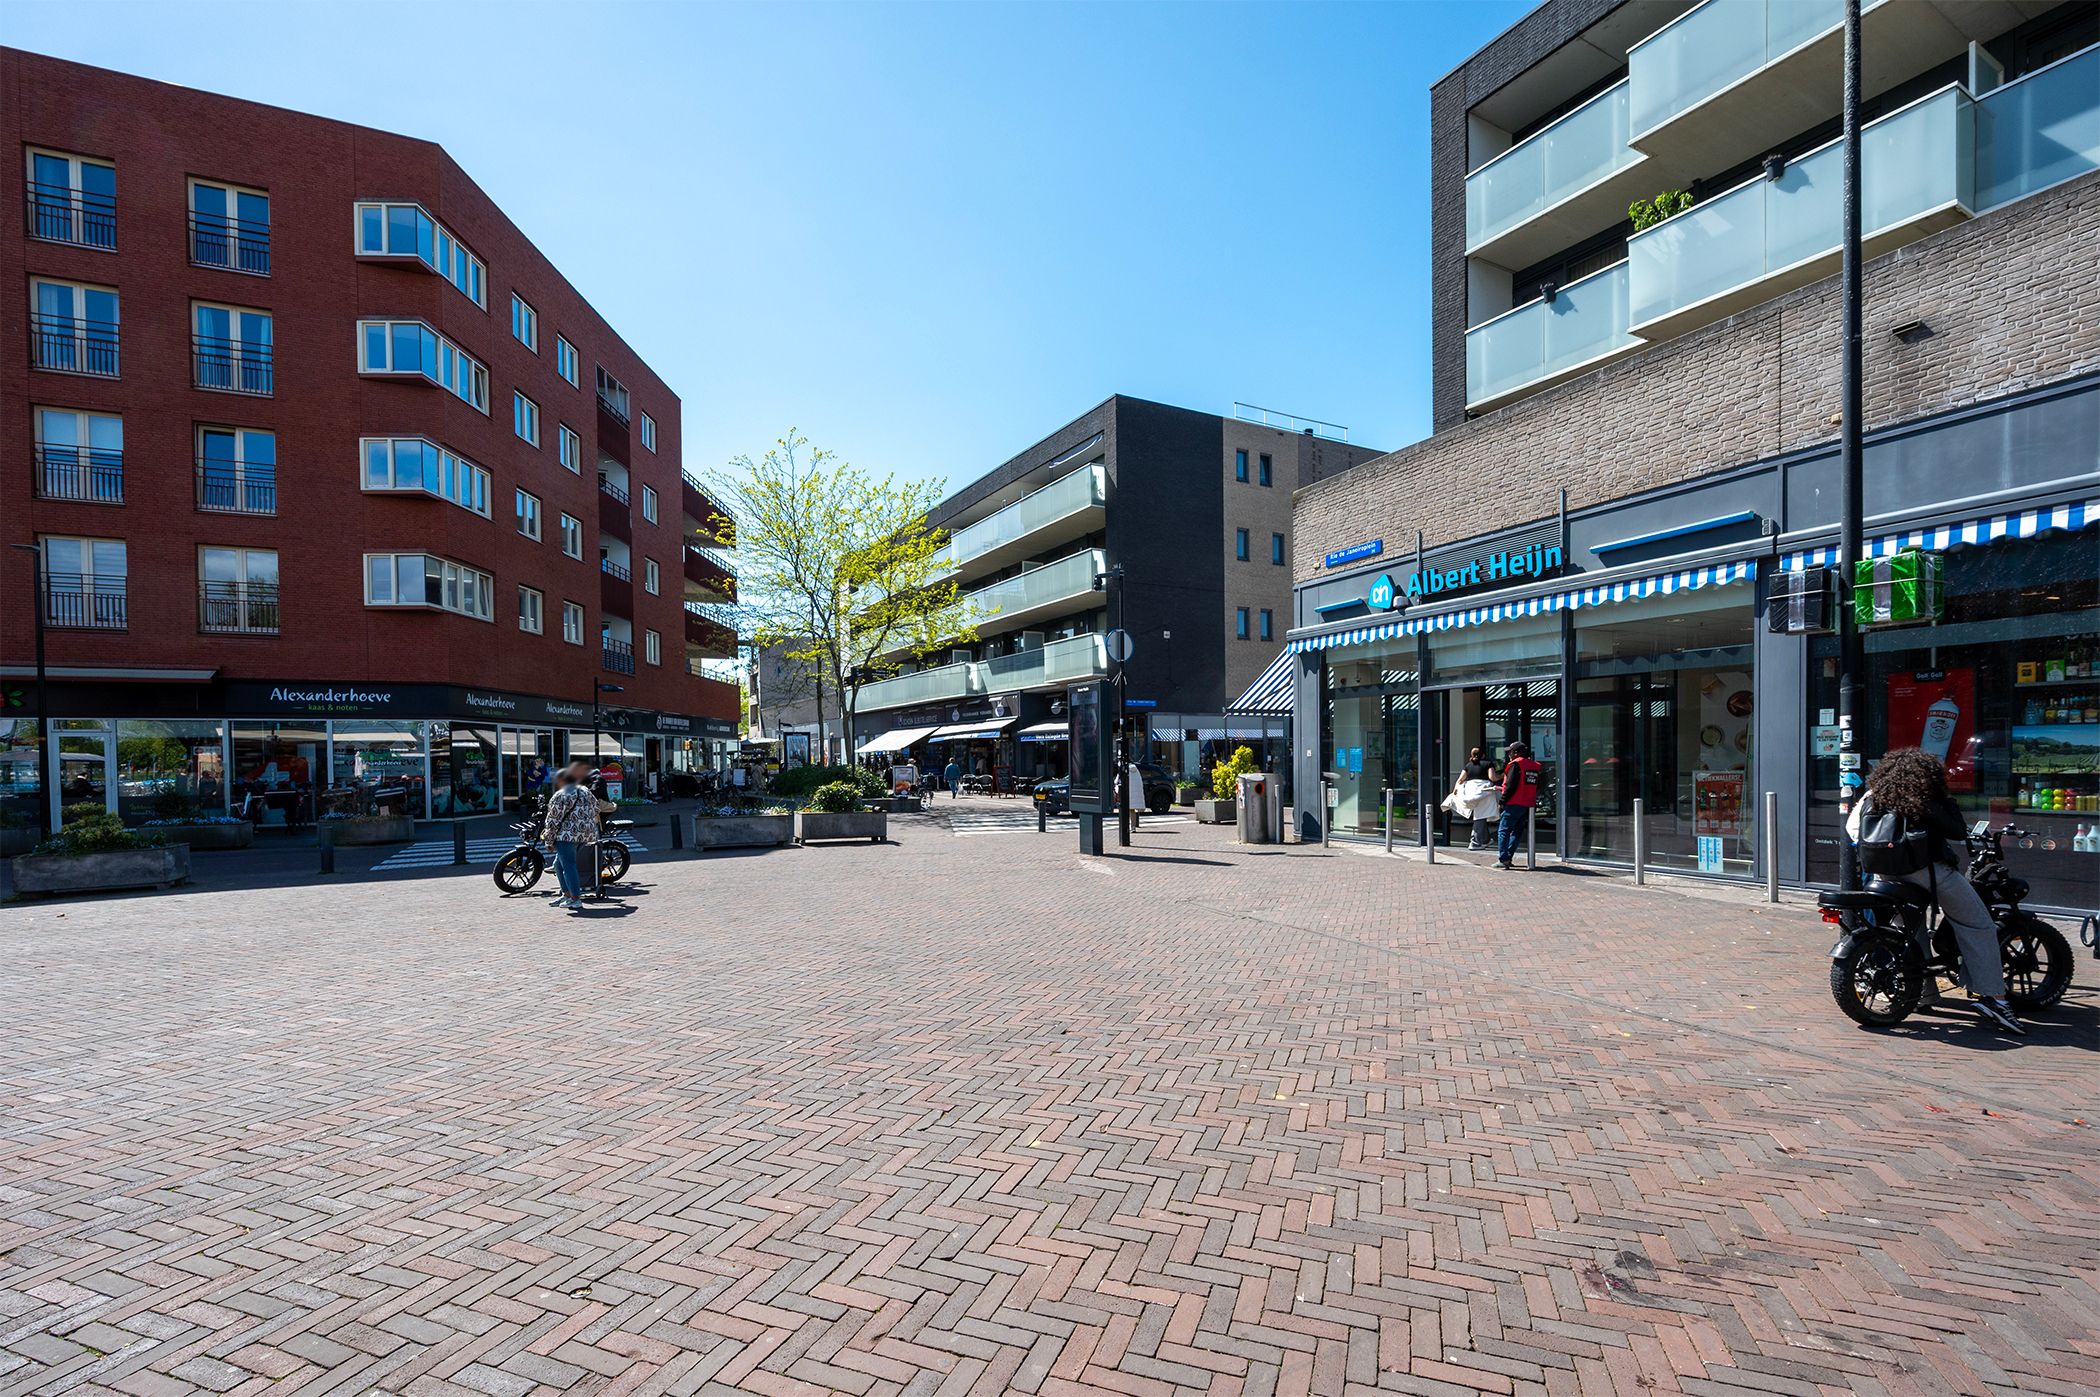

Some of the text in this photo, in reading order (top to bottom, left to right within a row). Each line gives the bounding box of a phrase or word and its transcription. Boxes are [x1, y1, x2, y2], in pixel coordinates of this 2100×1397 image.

[1407, 543, 1563, 598] Albert Heijn
[270, 687, 391, 702] Alexanderhoeve
[465, 693, 516, 710] Alexanderhoeve
[545, 702, 583, 716] Alexanderhoeve
